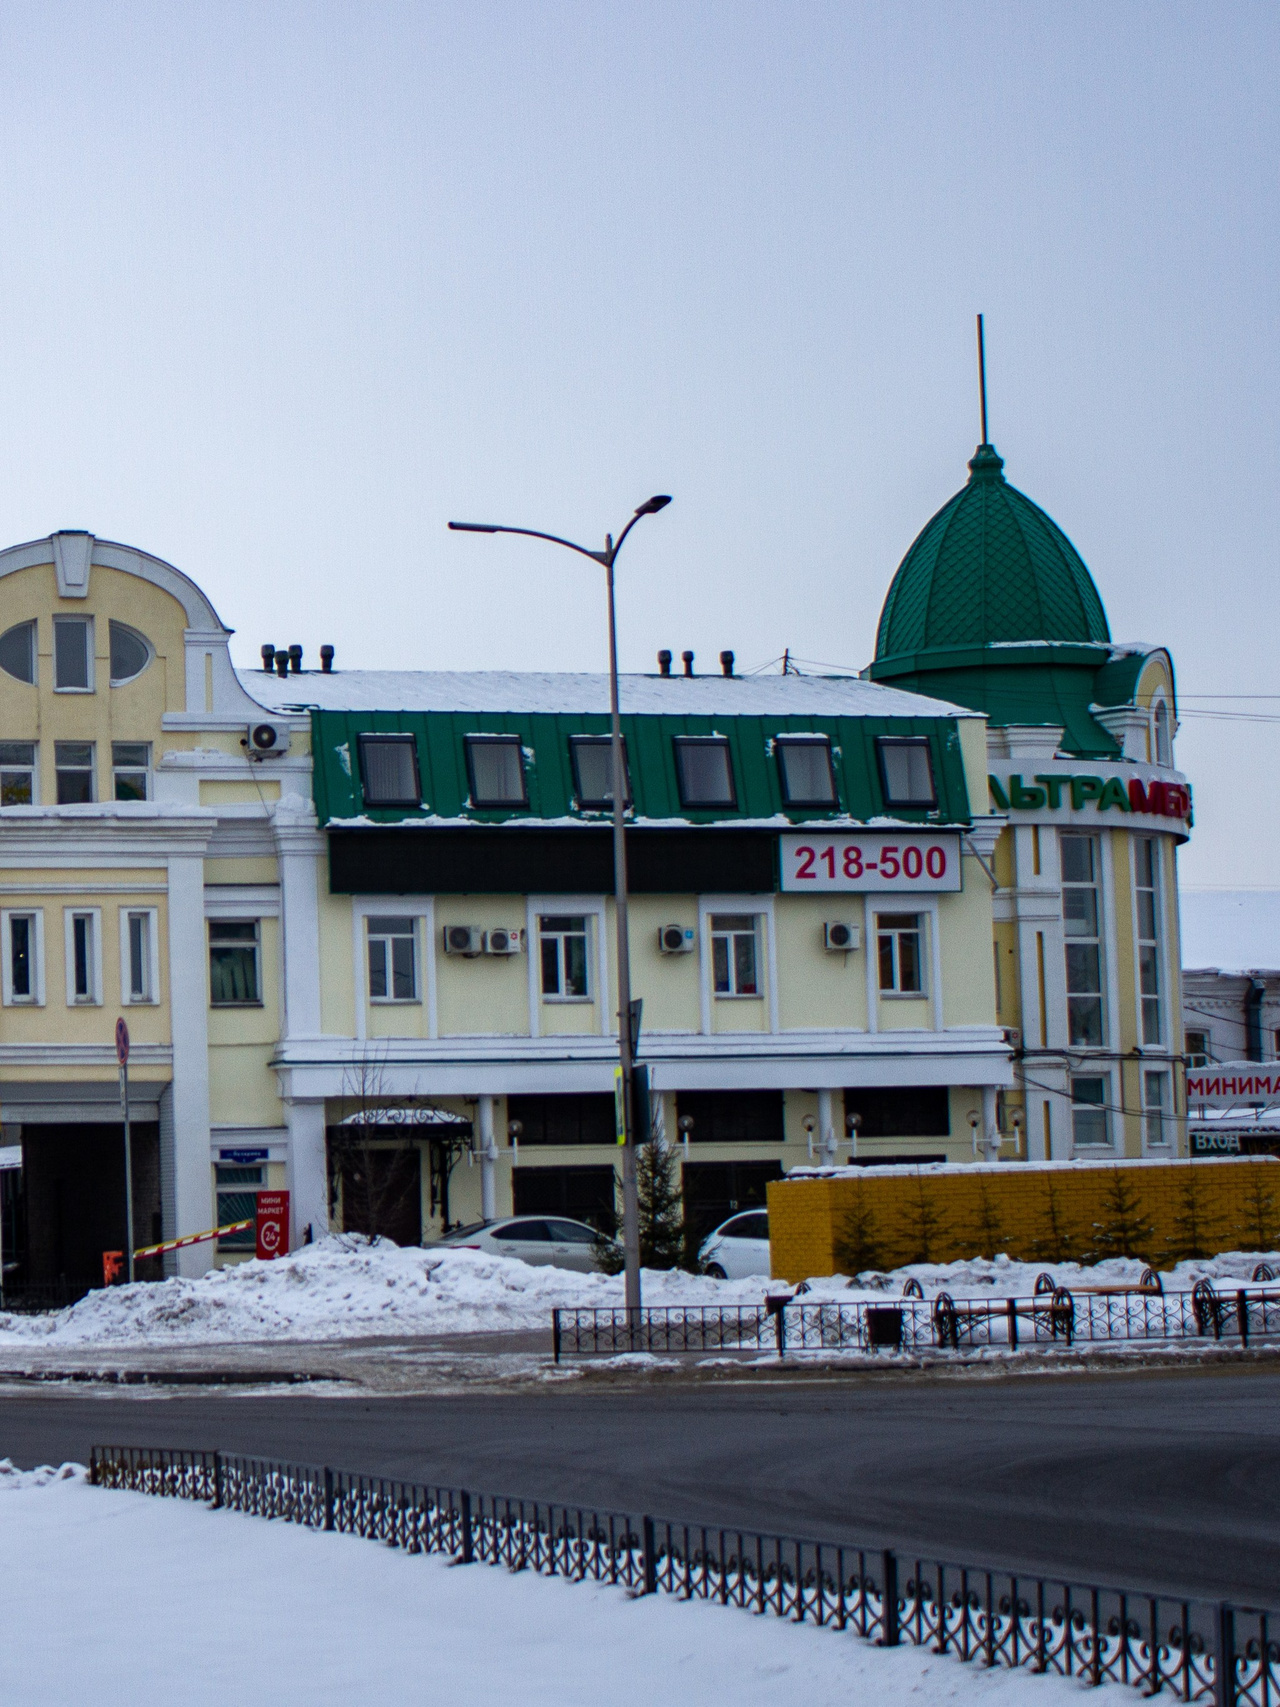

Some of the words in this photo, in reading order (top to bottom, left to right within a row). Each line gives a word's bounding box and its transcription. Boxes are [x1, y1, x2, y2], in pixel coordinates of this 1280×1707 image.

[794, 845, 947, 880] 218-500
[1195, 1134, 1239, 1152] ВХОД
[261, 1197, 281, 1205] МИНИ
[258, 1206, 284, 1215] МАРКЕТ
[265, 1231, 276, 1242] 24
